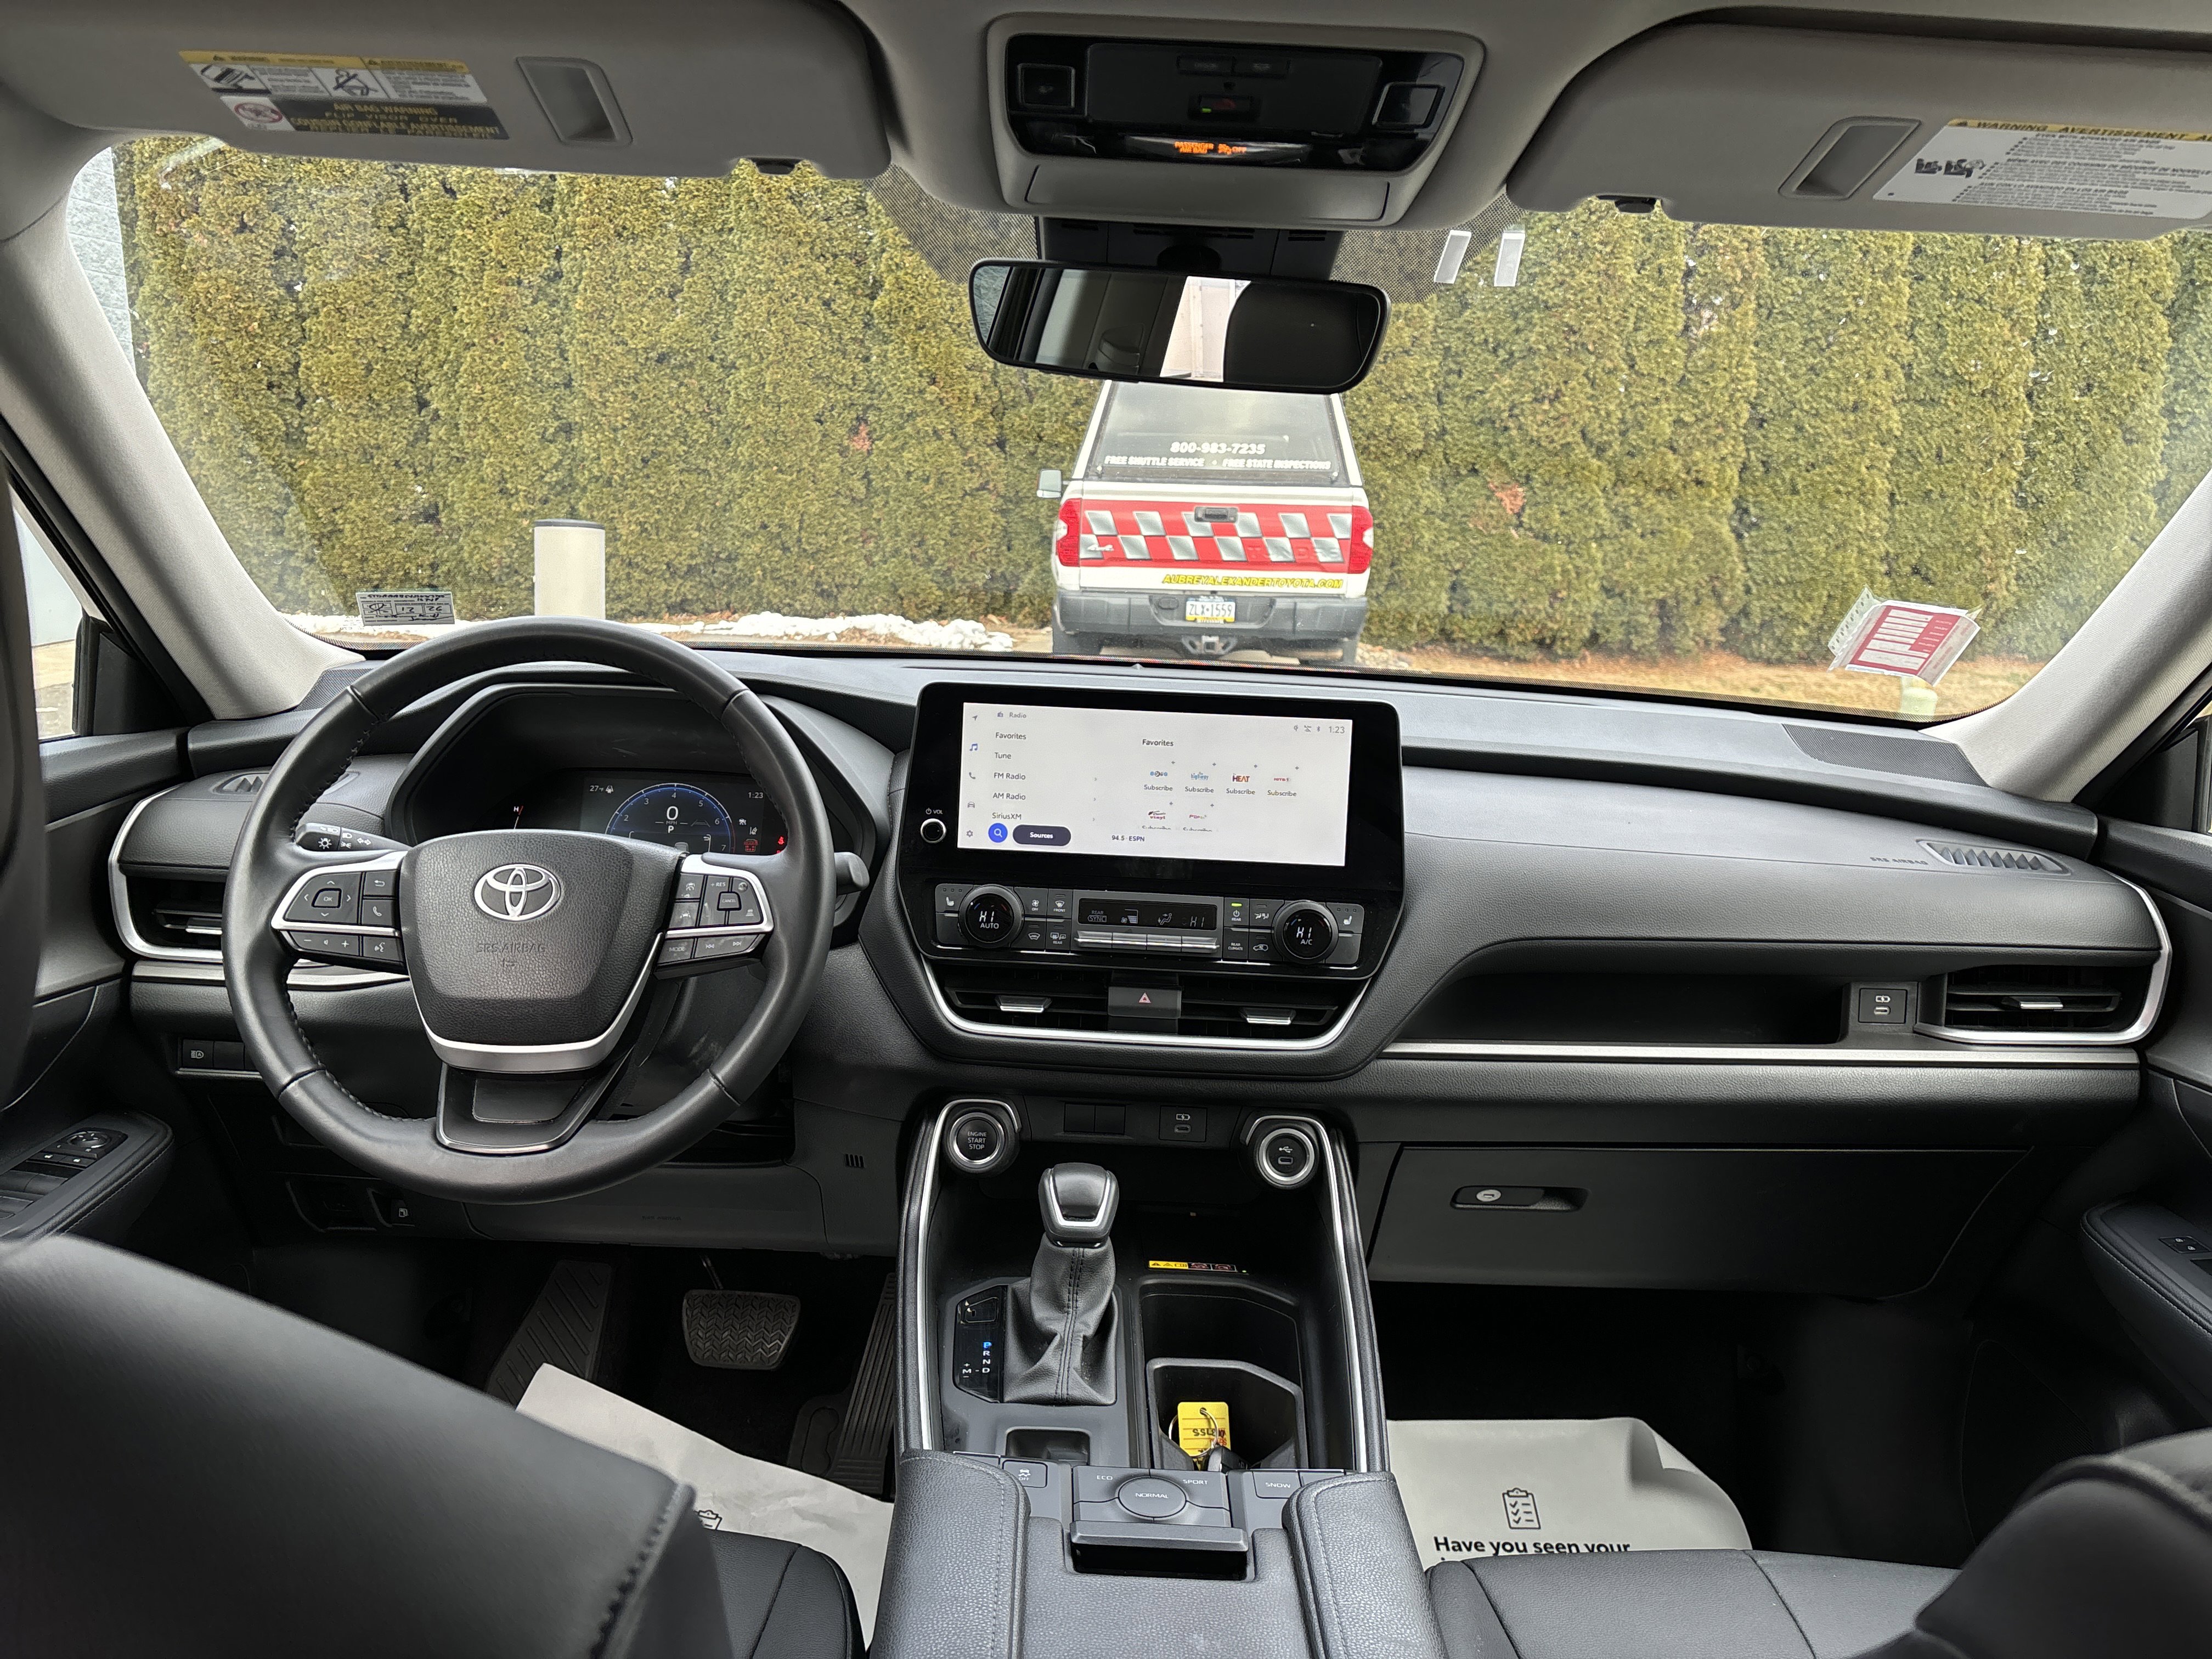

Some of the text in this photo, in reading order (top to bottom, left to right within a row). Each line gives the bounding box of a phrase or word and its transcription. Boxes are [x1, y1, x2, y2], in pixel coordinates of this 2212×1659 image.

[1977, 120, 2049, 132] WARNING
[1175, 141, 1214, 150] PASSENGER
[1170, 442, 1266, 455] 800-983-7235
[1104, 455, 1205, 467] FREE SHUTTLE SERVICE
[1222, 459, 1331, 470] FREE STATE INSPECTIONS
[1163, 574, 1343, 589] AUBREYALEXANDERTOYOTA.COM
[995, 732, 1027, 740] Favorites
[1328, 726, 1346, 735] 1:23
[1142, 738, 1174, 747] Favorites
[666, 806, 679, 821] 0
[992, 812, 1022, 820] SiriusXM
[668, 825, 674, 833] P
[979, 910, 995, 922] HI
[1296, 926, 1312, 938] HI
[476, 941, 546, 953] SRS AIRBAG
[1434, 1536, 1486, 1553] Have
[1489, 1540, 1528, 1556] you
[1533, 1541, 1580, 1554] seen
